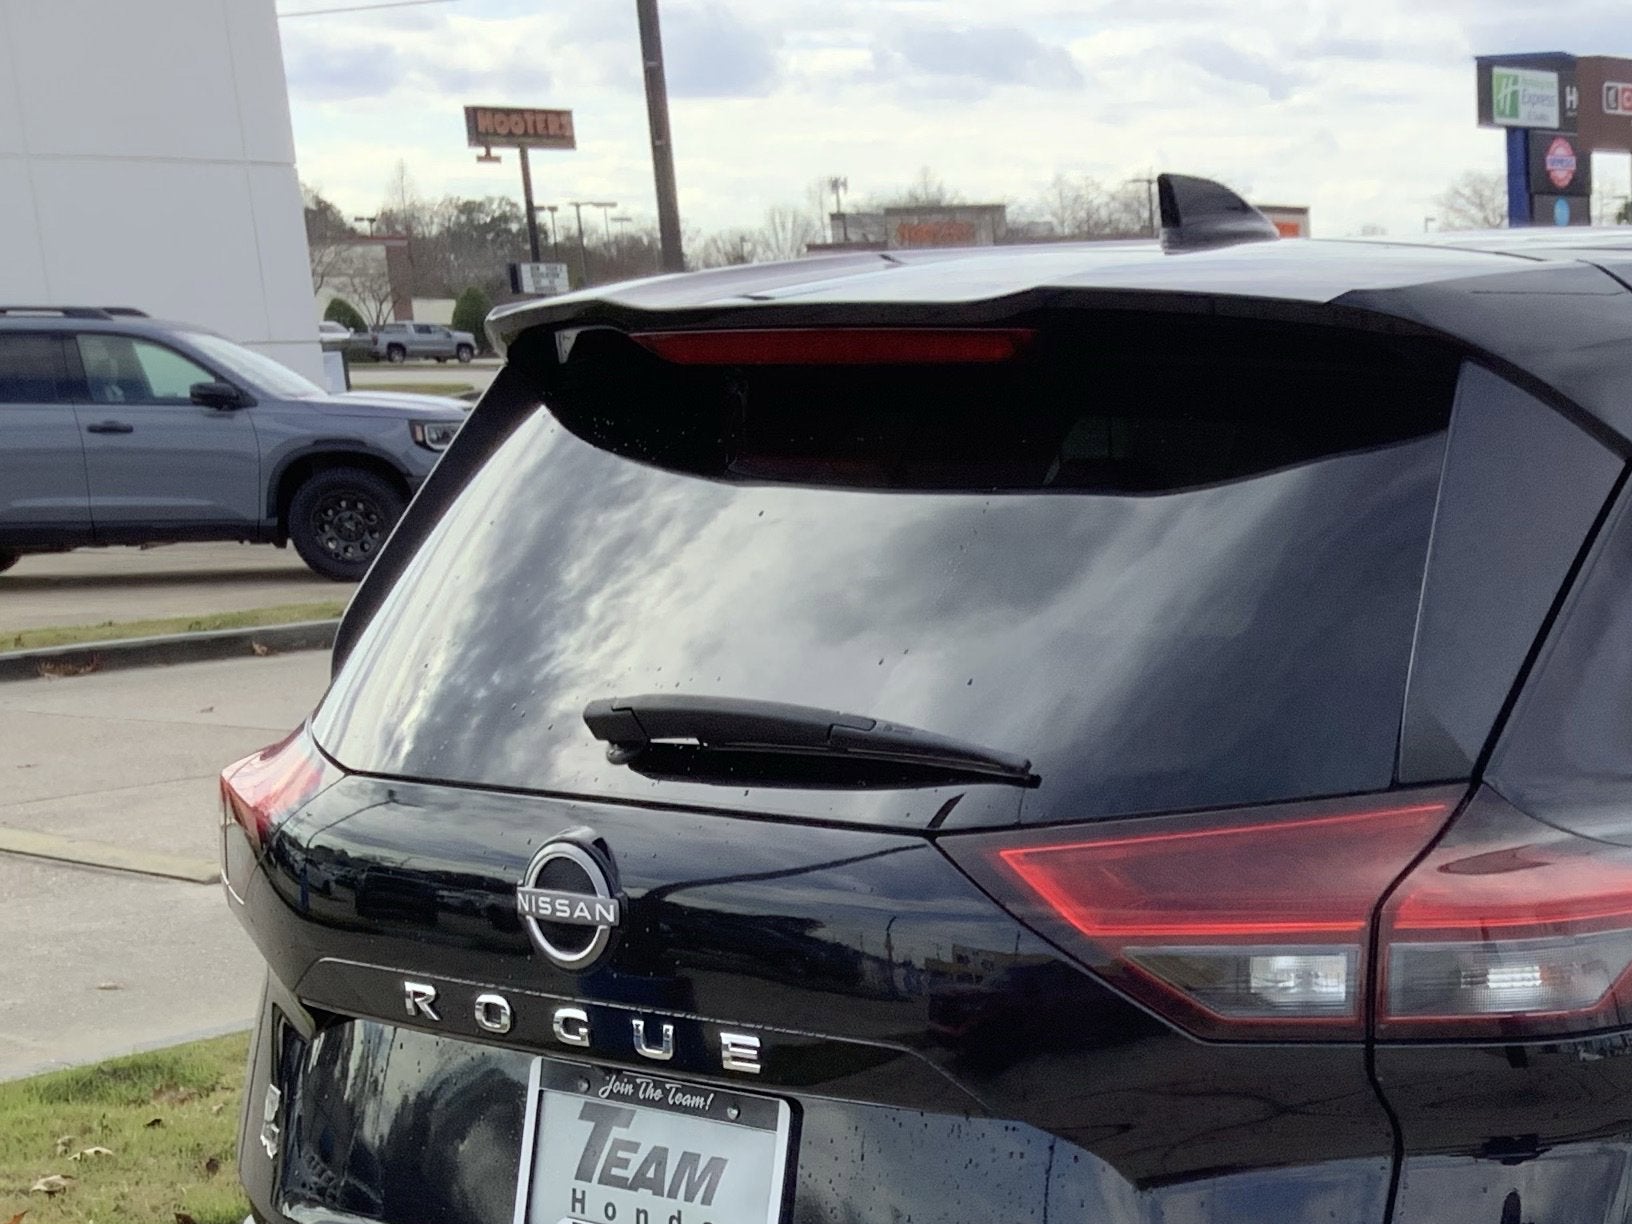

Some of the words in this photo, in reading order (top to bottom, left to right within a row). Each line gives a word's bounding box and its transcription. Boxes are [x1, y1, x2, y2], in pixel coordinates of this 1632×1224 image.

[478, 111, 573, 136] HOOTERS
[517, 892, 615, 923] NISSAN
[404, 980, 762, 1075] ROGUE
[598, 1074, 634, 1099] Join
[636, 1077, 664, 1102] The
[666, 1083, 715, 1111] Team!
[574, 1100, 729, 1207] TEAM
